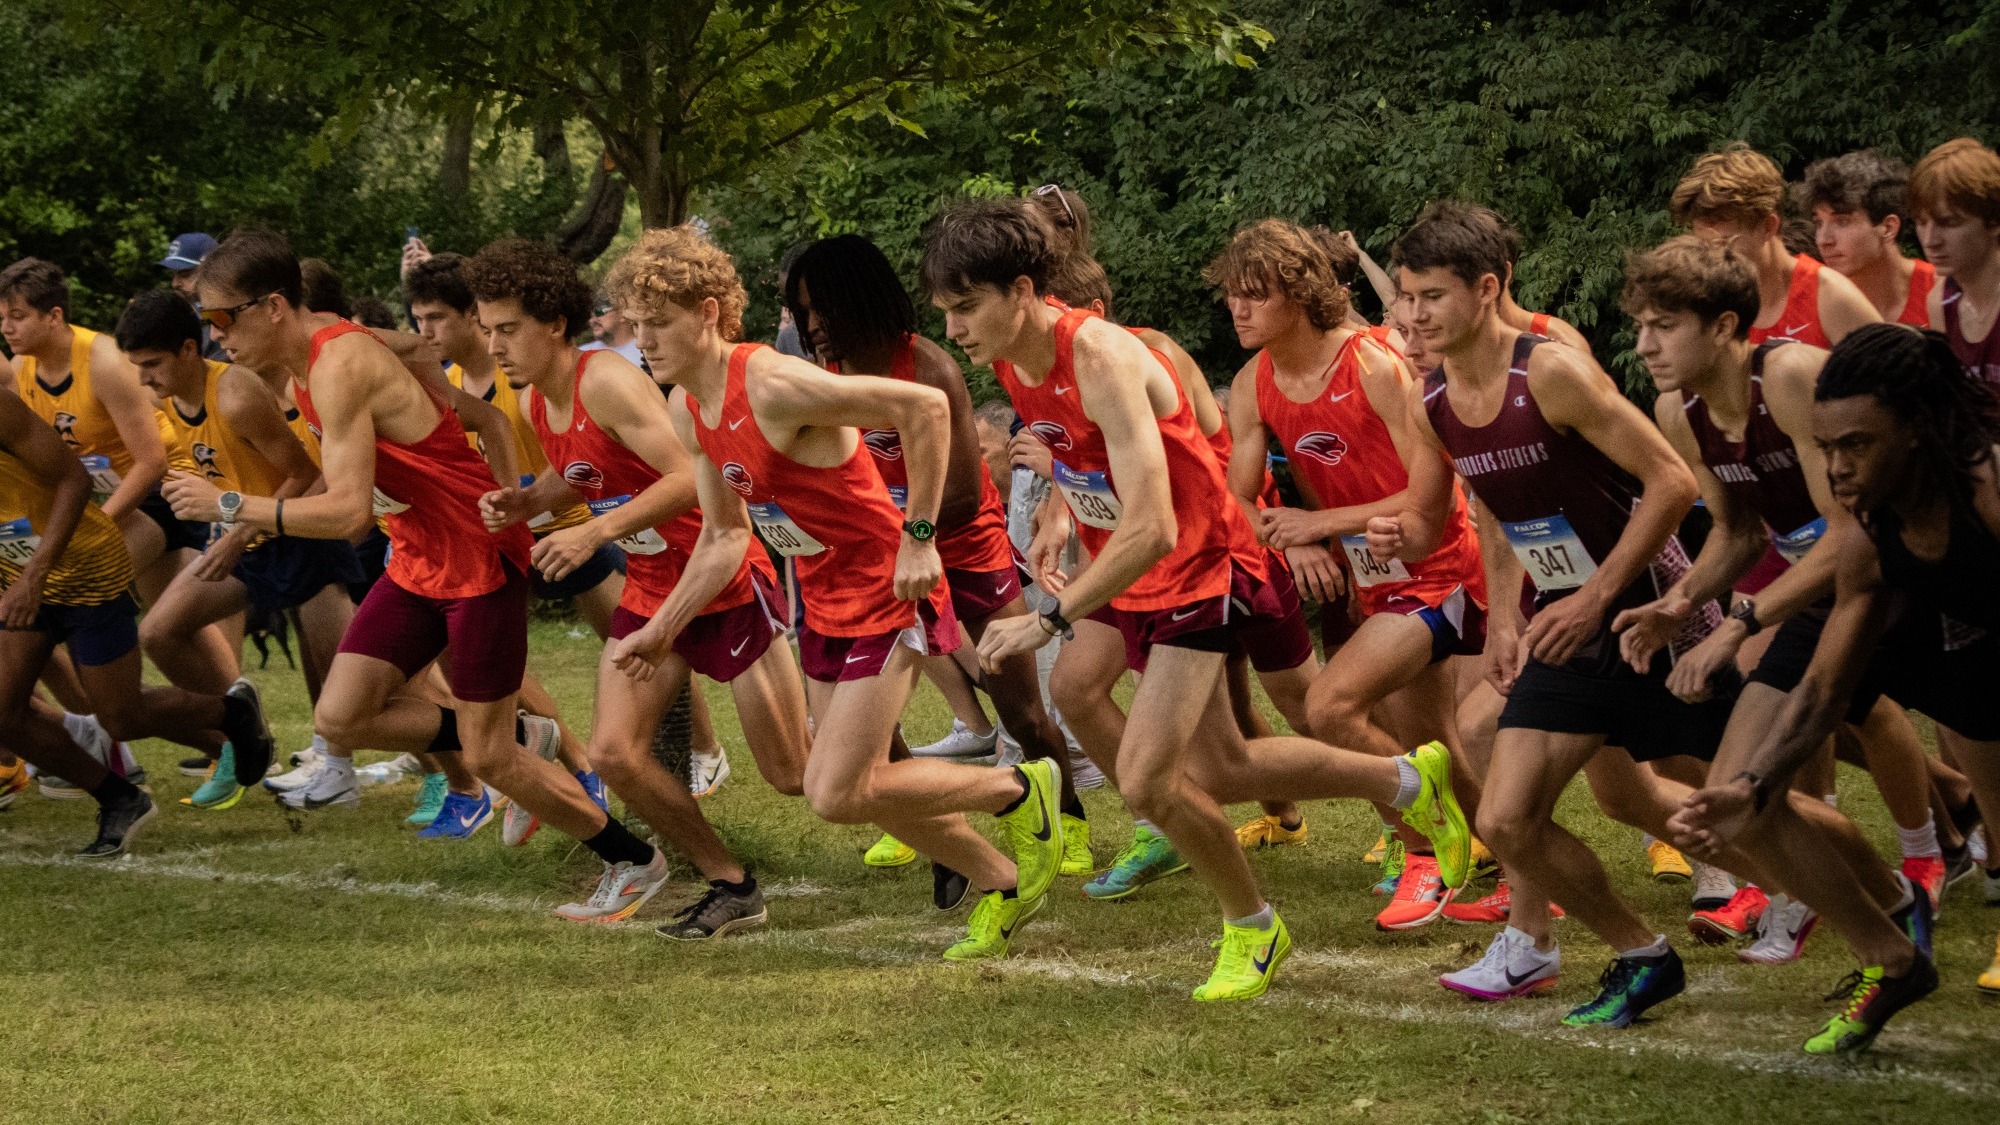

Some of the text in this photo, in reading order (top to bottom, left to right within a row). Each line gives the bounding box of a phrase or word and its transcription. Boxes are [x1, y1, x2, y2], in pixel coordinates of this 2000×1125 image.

[1497, 442, 1549, 470] STEVENS
[1071, 491, 1116, 521] 339
[761, 524, 802, 549] 330
[1513, 521, 1550, 532] FALCON
[0, 540, 36, 559] 315
[1529, 544, 1576, 578] 347
